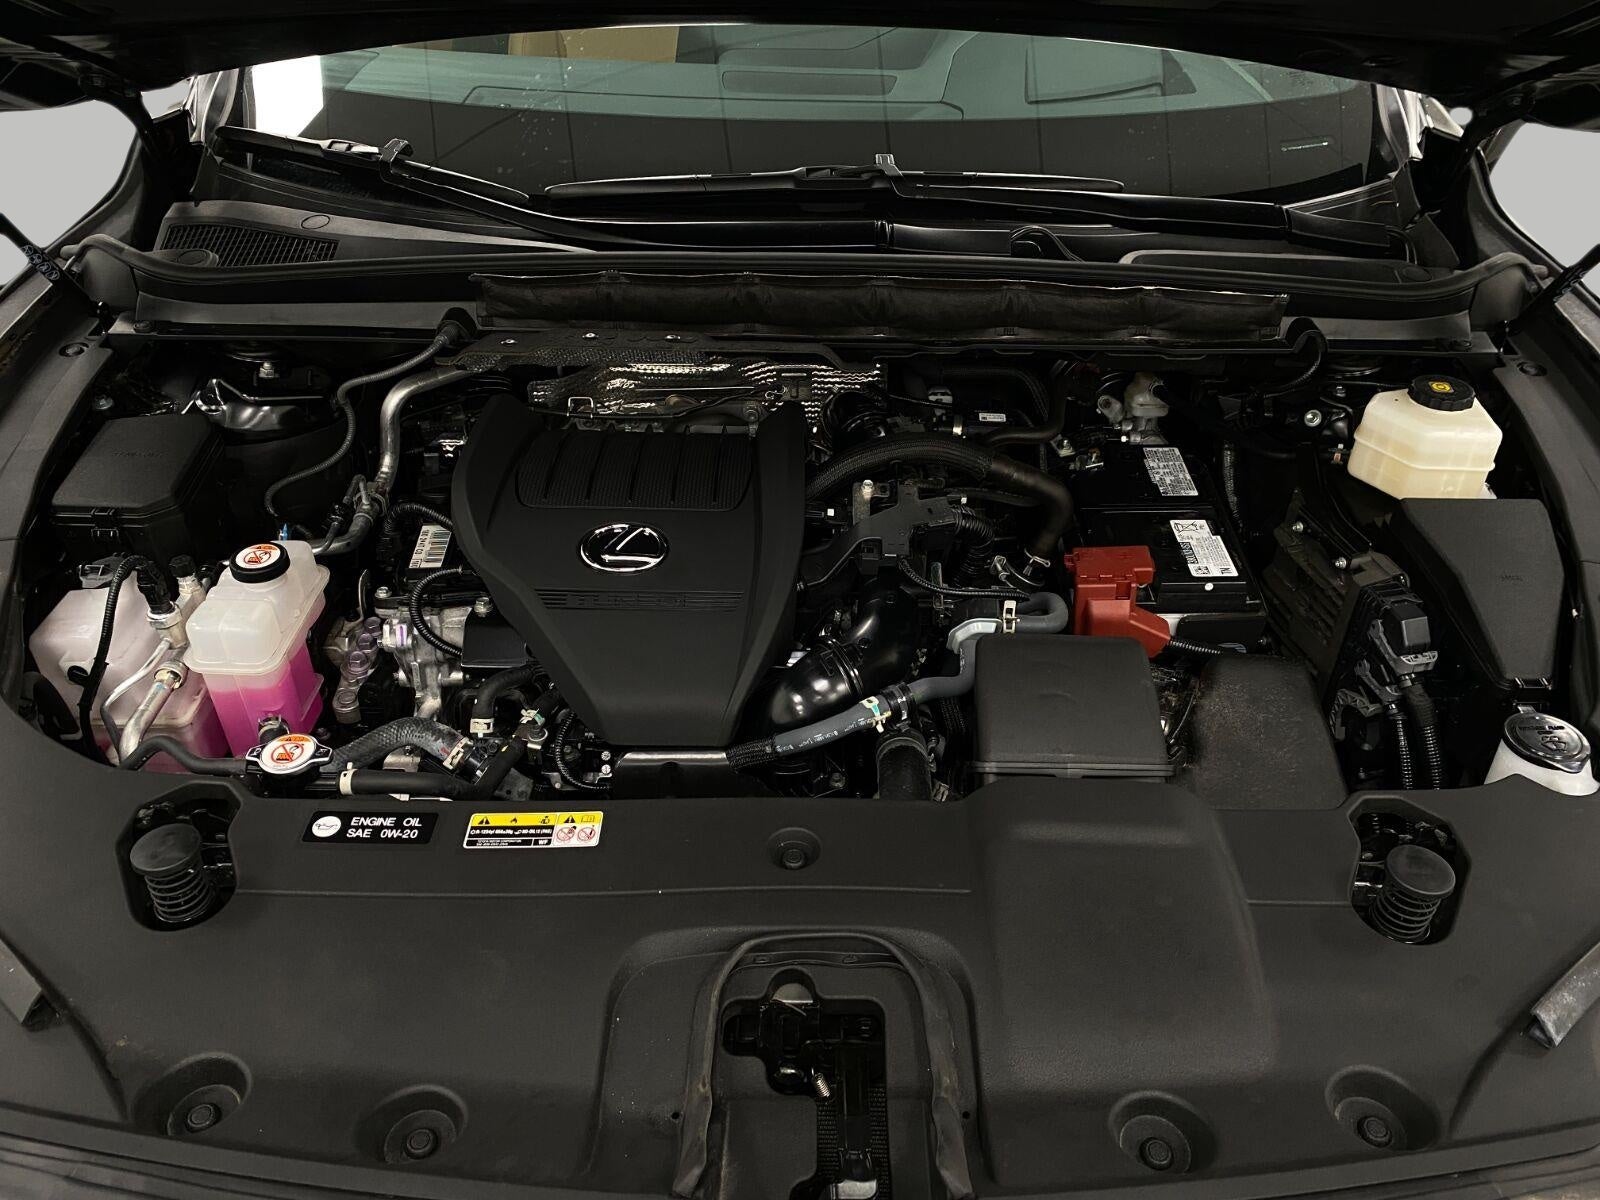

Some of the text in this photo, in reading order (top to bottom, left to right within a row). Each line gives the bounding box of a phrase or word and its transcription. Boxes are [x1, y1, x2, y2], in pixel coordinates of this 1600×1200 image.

[350, 816, 422, 827] ENGINE OIL
[346, 828, 419, 839] SAE 0W-20
